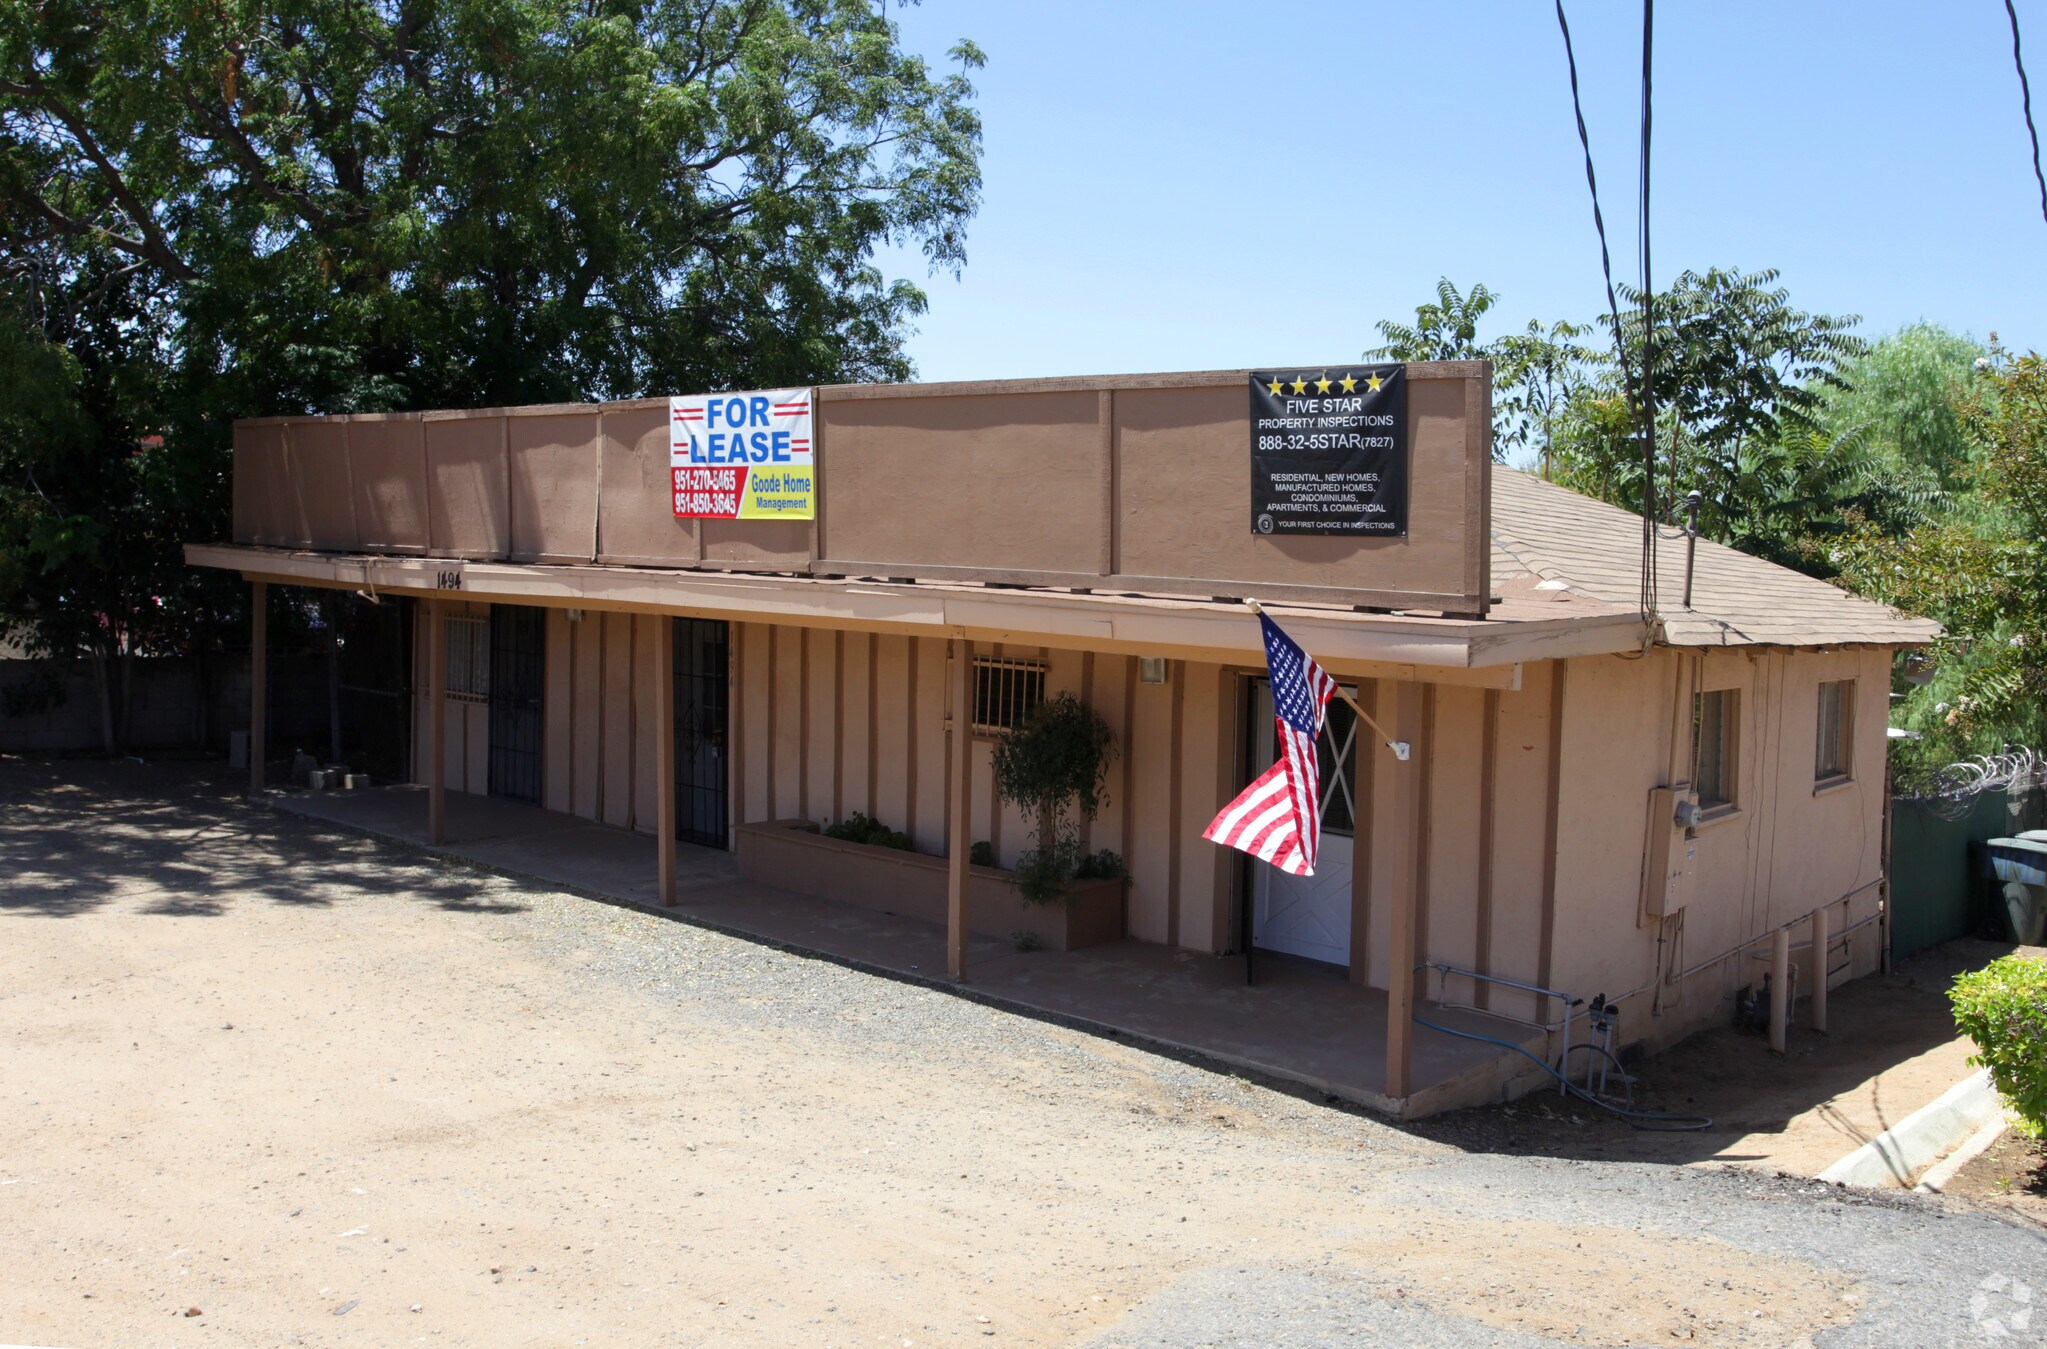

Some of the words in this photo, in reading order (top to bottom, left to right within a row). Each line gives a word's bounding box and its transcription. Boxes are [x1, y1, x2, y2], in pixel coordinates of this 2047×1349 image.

[708, 397, 770, 428] FOR
[1286, 400, 1318, 414] FIVE
[1322, 398, 1362, 412] STAR
[1258, 418, 1315, 429] PROPERTY
[1318, 415, 1394, 428] INSPECTIONS
[690, 431, 791, 463] LEASE
[674, 470, 736, 490] 951-270-5465
[752, 474, 780, 492] Goode
[784, 473, 810, 492] Home
[1270, 473, 1323, 482] RESIDENTIAL,
[1325, 474, 1344, 482] NEW
[1346, 473, 1380, 482] HOMES,
[1275, 484, 1340, 492] MANUFACTURED
[1342, 484, 1376, 492] HOMES,
[675, 492, 736, 514] 951-850-3645
[756, 497, 806, 511] Management
[1291, 494, 1358, 503] CONDOMINIUMS,
[1266, 504, 1320, 513] APARTMENTS,
[1322, 504, 1328, 512] &
[1330, 504, 1386, 512] COMMERCIAL
[1351, 522, 1395, 530] INSPECTIONS
[437, 570, 462, 589] 1494
